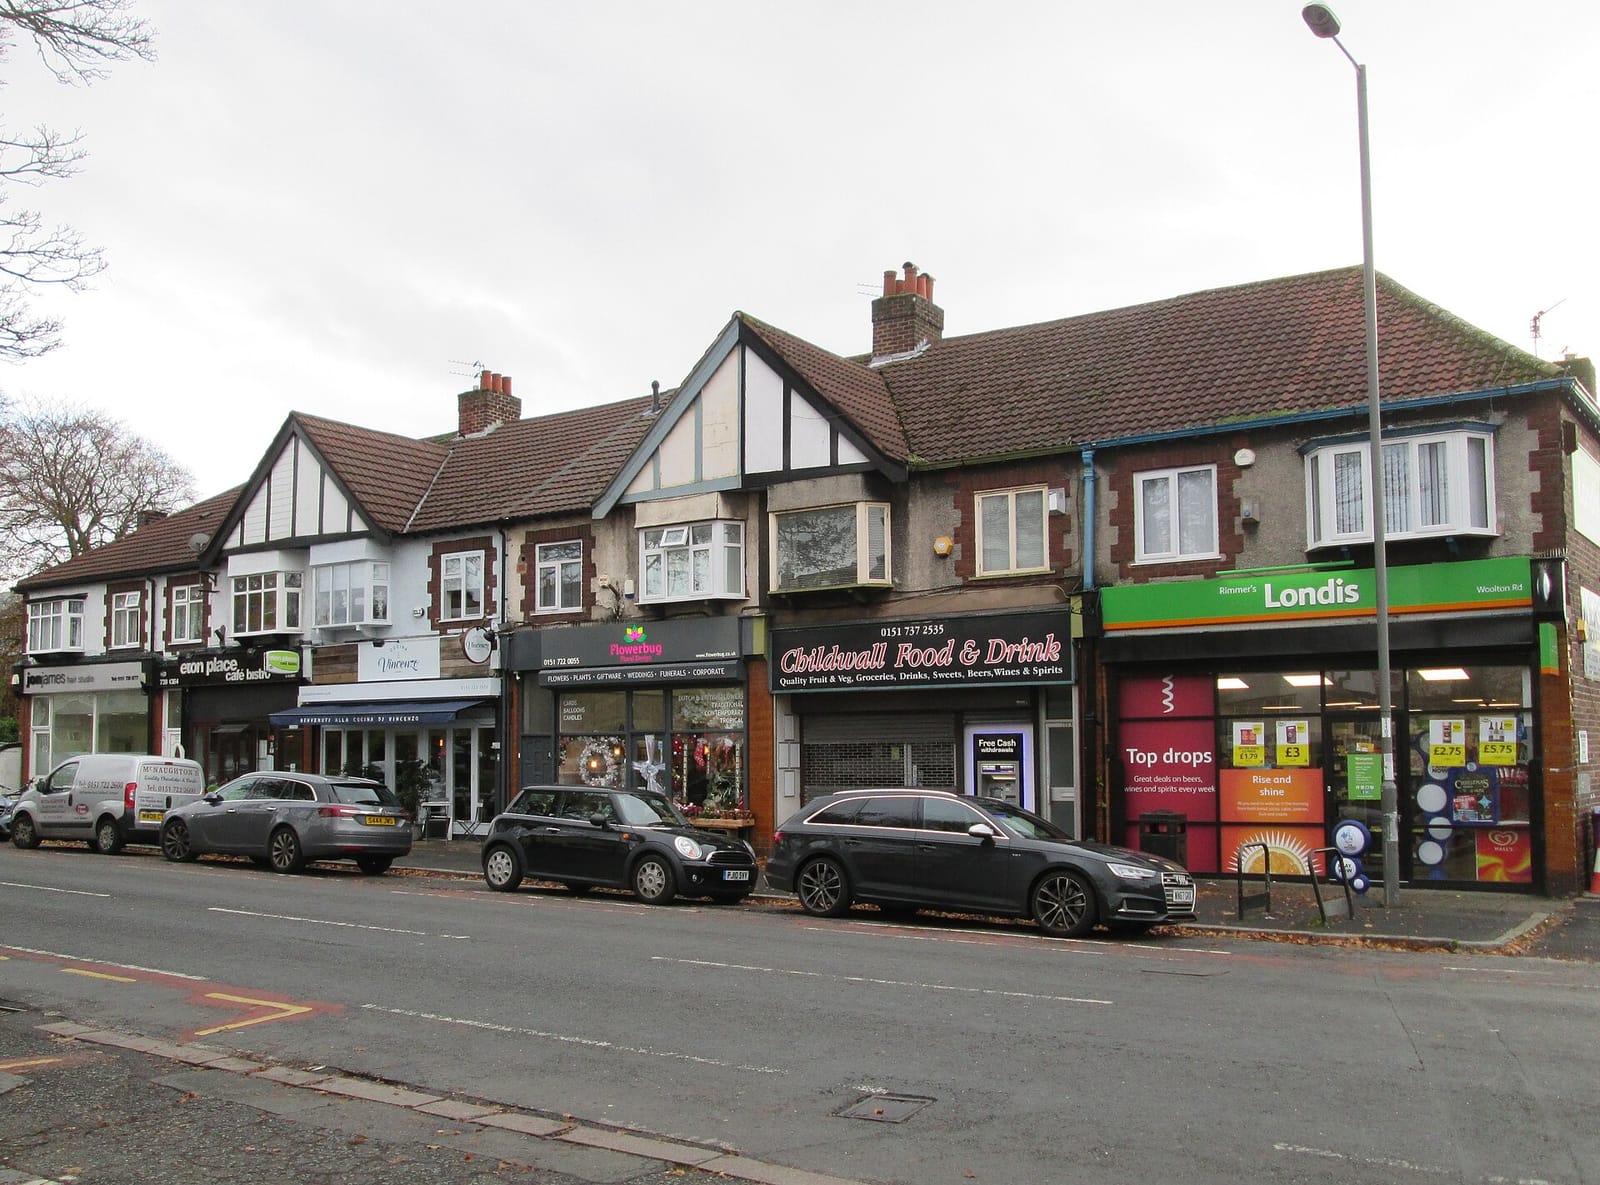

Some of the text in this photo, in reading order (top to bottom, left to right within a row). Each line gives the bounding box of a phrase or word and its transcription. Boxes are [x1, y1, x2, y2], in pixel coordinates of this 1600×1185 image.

[1219, 585, 1257, 595] Rimmer's
[1264, 578, 1360, 608] Londis
[1477, 583, 1523, 593] Woolton Rd
[881, 625, 944, 637] 0151 737 2535
[610, 643, 662, 656] Flowerbug
[781, 633, 1061, 674] Childwall Food & Drink
[180, 657, 237, 676] eton place
[26, 672, 66, 688] jonjames
[225, 668, 245, 681] café
[548, 675, 570, 683] FLOWERS
[628, 671, 654, 679] WEDDINGS
[660, 669, 686, 677] FUNERALS
[693, 668, 725, 676] CORPORATE
[780, 676, 807, 687] Quality
[809, 675, 828, 685] Fruit
[830, 675, 836, 683] &
[856, 672, 897, 682] Groceries,
[899, 671, 930, 681] Drinks,
[932, 671, 965, 679] Sweets,
[1022, 667, 1030, 675] &
[1033, 666, 1063, 677] Spirits
[979, 739, 1016, 747] Free Cash
[1286, 747, 1300, 758] £3
[1434, 747, 1461, 756] £2.75
[1484, 745, 1512, 754] £5.75
[1126, 747, 1212, 768] Top drops
[1134, 775, 1152, 783] Great
[1154, 775, 1171, 783] deals
[1183, 776, 1203, 784] beers,
[1252, 775, 1292, 784] Rise and
[1157, 785, 1177, 794] spirits
[1178, 787, 1197, 795] every
[1259, 788, 1285, 797] shine
